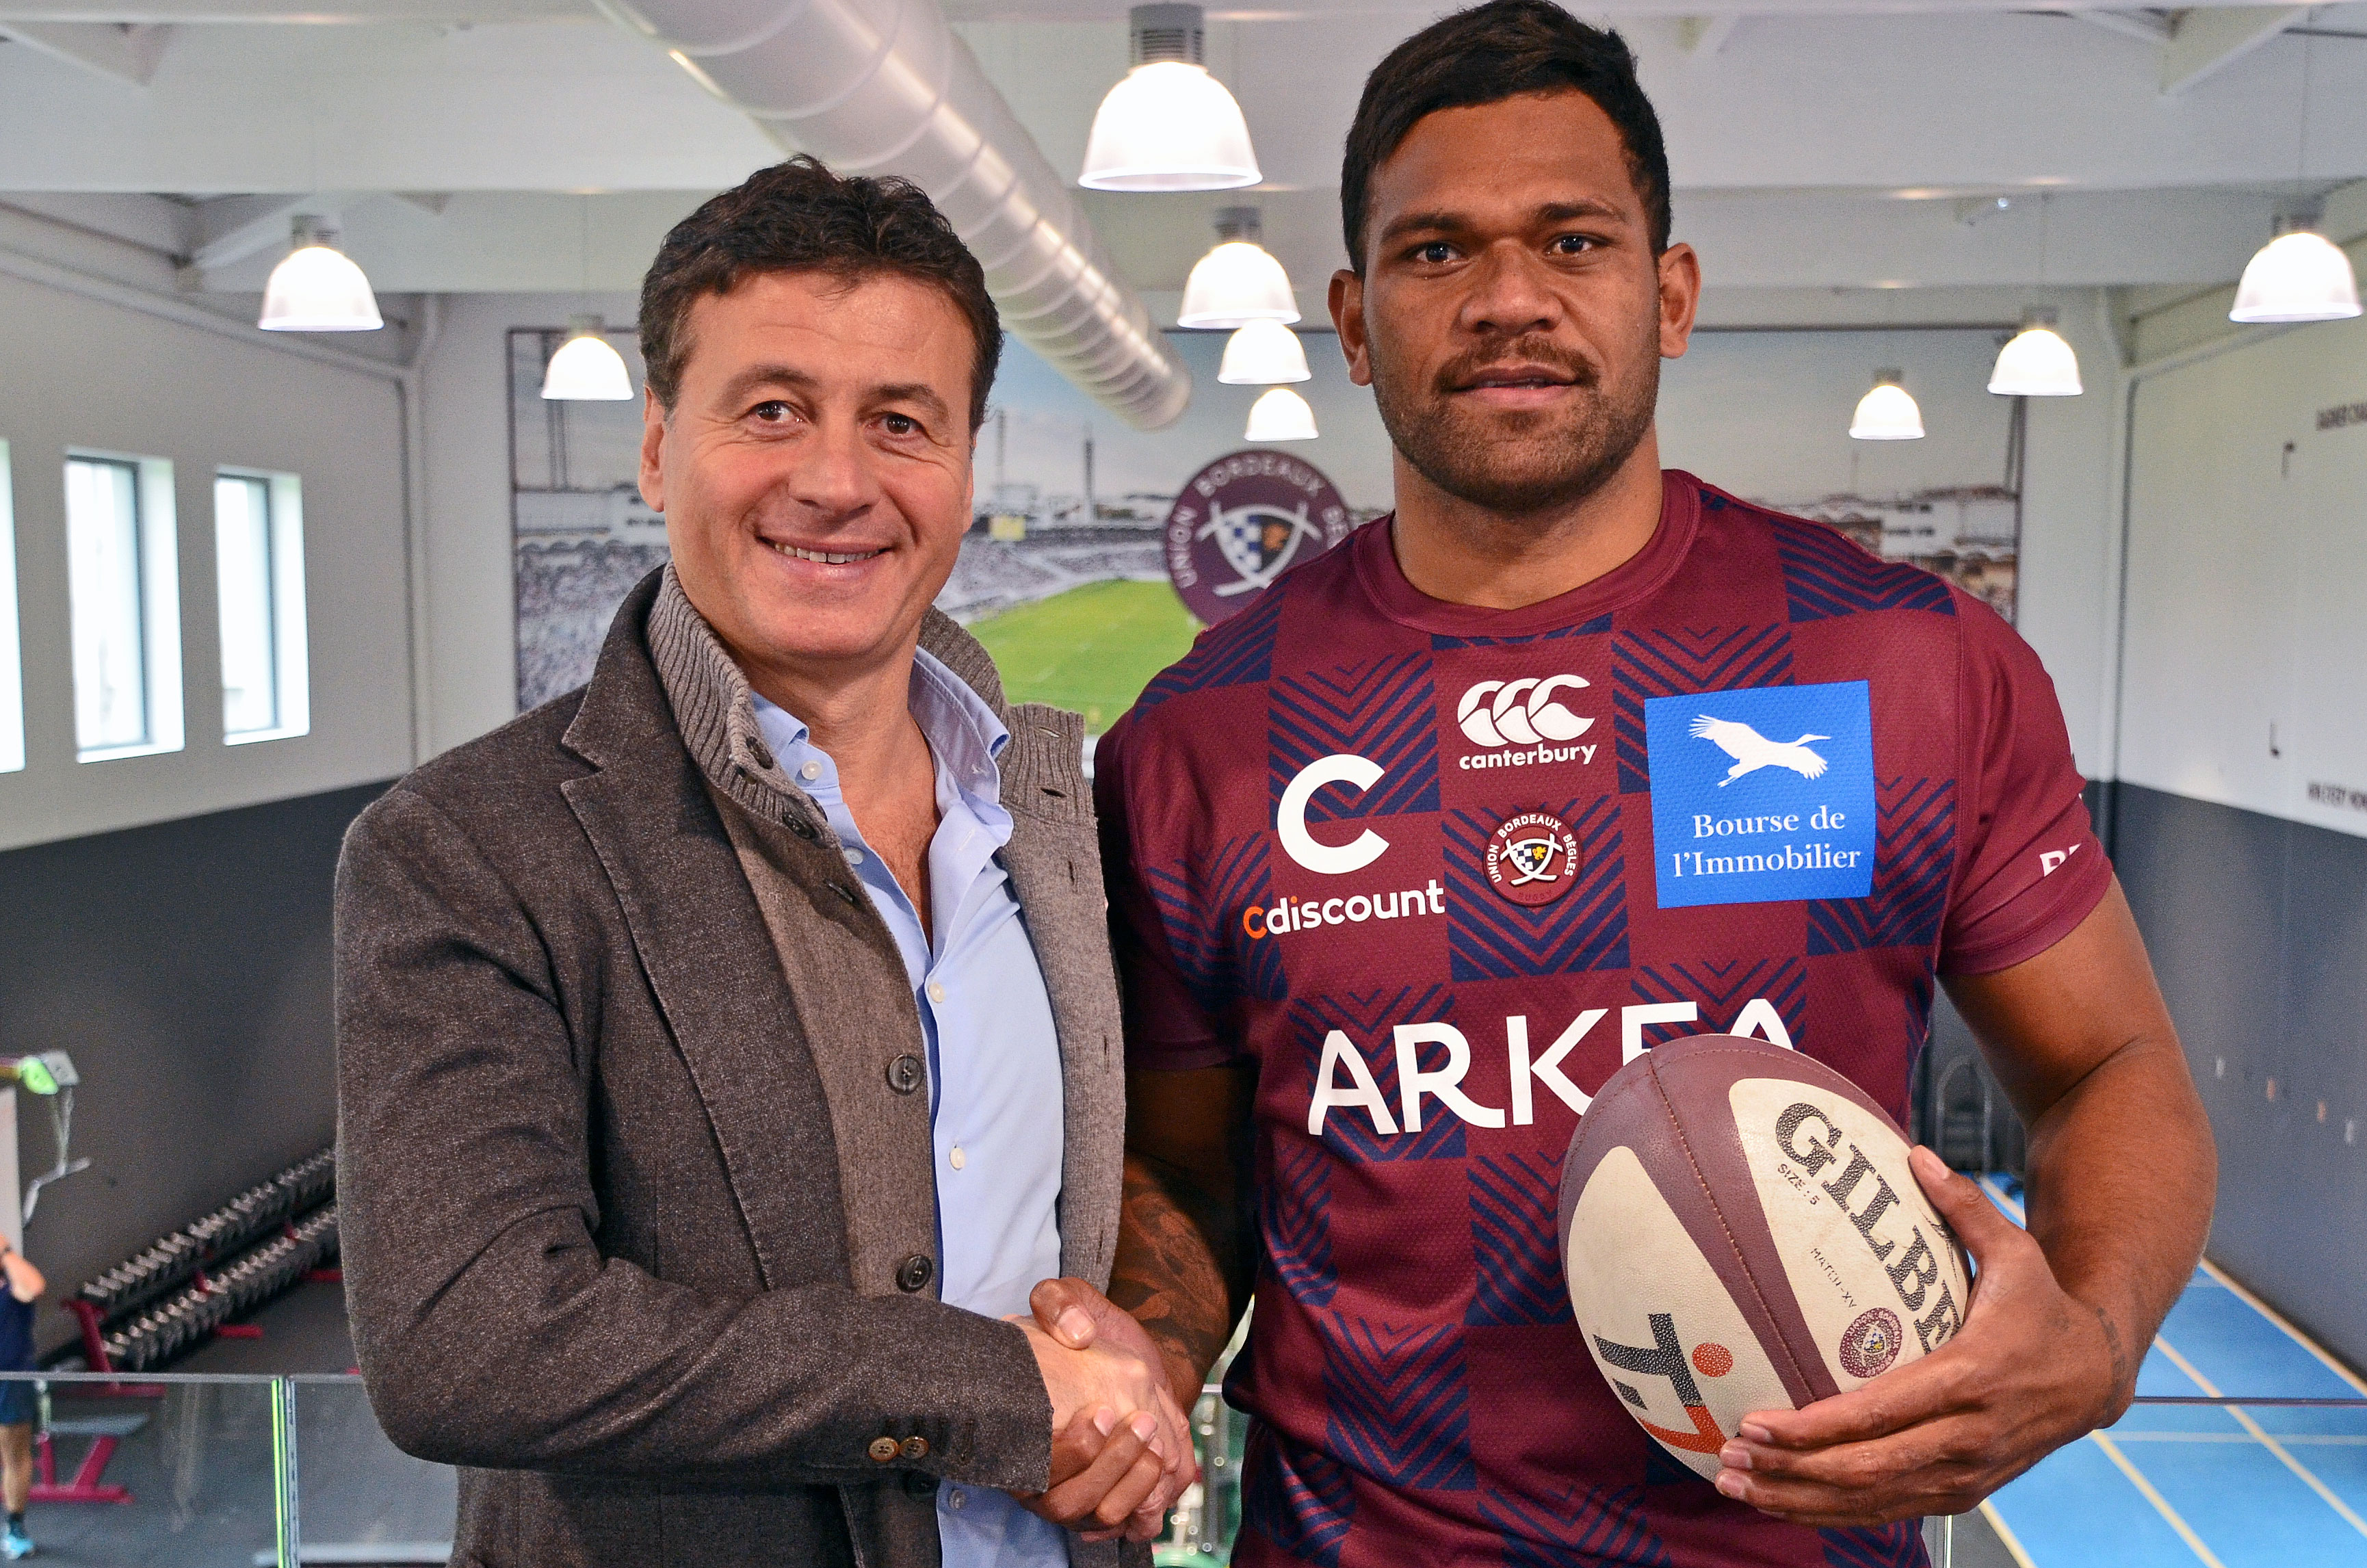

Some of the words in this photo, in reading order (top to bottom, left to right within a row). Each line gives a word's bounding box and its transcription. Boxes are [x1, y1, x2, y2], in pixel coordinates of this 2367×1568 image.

[1168, 505, 1198, 589] UNION
[1193, 454, 1326, 498] BORDEAUX
[1459, 742, 1597, 771] canterbury
[1692, 813, 1799, 839] Bourse
[1810, 805, 1846, 831] de
[1487, 844, 1503, 884] UNION
[1497, 813, 1562, 839] BORDEAUX
[1672, 843, 1861, 878] l'Immobilier
[1242, 878, 1446, 940] Cdiscount
[1777, 1163, 1806, 1192] SIZE
[1775, 1102, 1961, 1355] GILBE
